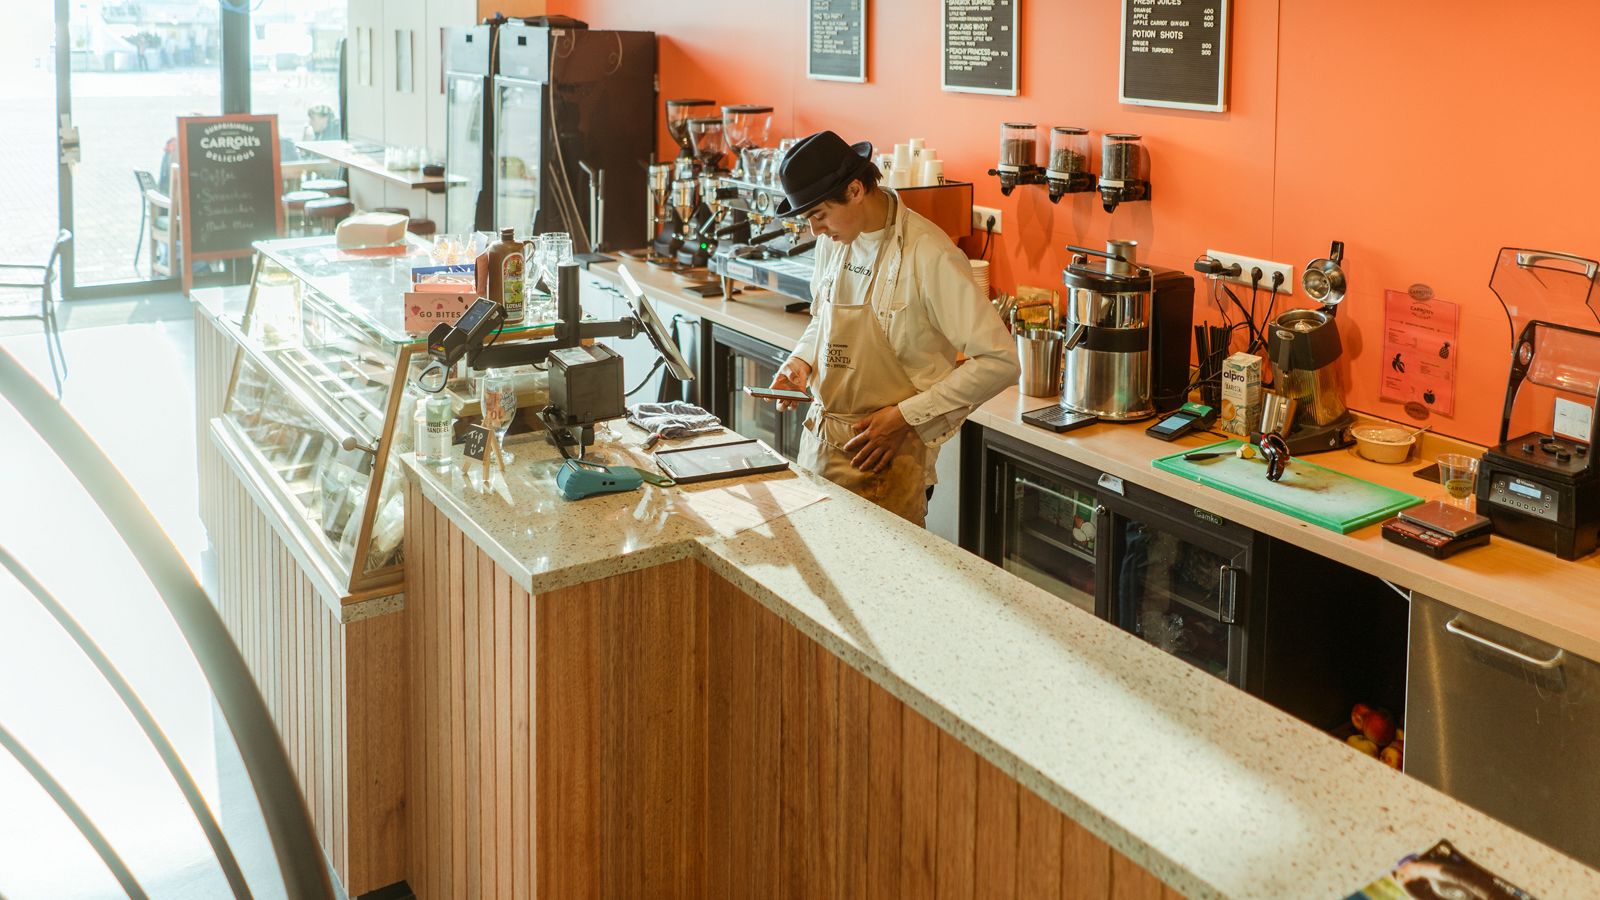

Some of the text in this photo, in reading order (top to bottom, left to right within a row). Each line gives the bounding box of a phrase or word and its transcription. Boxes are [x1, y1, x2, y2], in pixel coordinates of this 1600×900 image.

[1132, 29, 1183, 40] POTION SHOTS
[205, 149, 255, 163] DELICIOUS
[1223, 370, 1245, 383] alpro
[468, 429, 484, 444] Tip
[1196, 510, 1219, 524] Gamko
